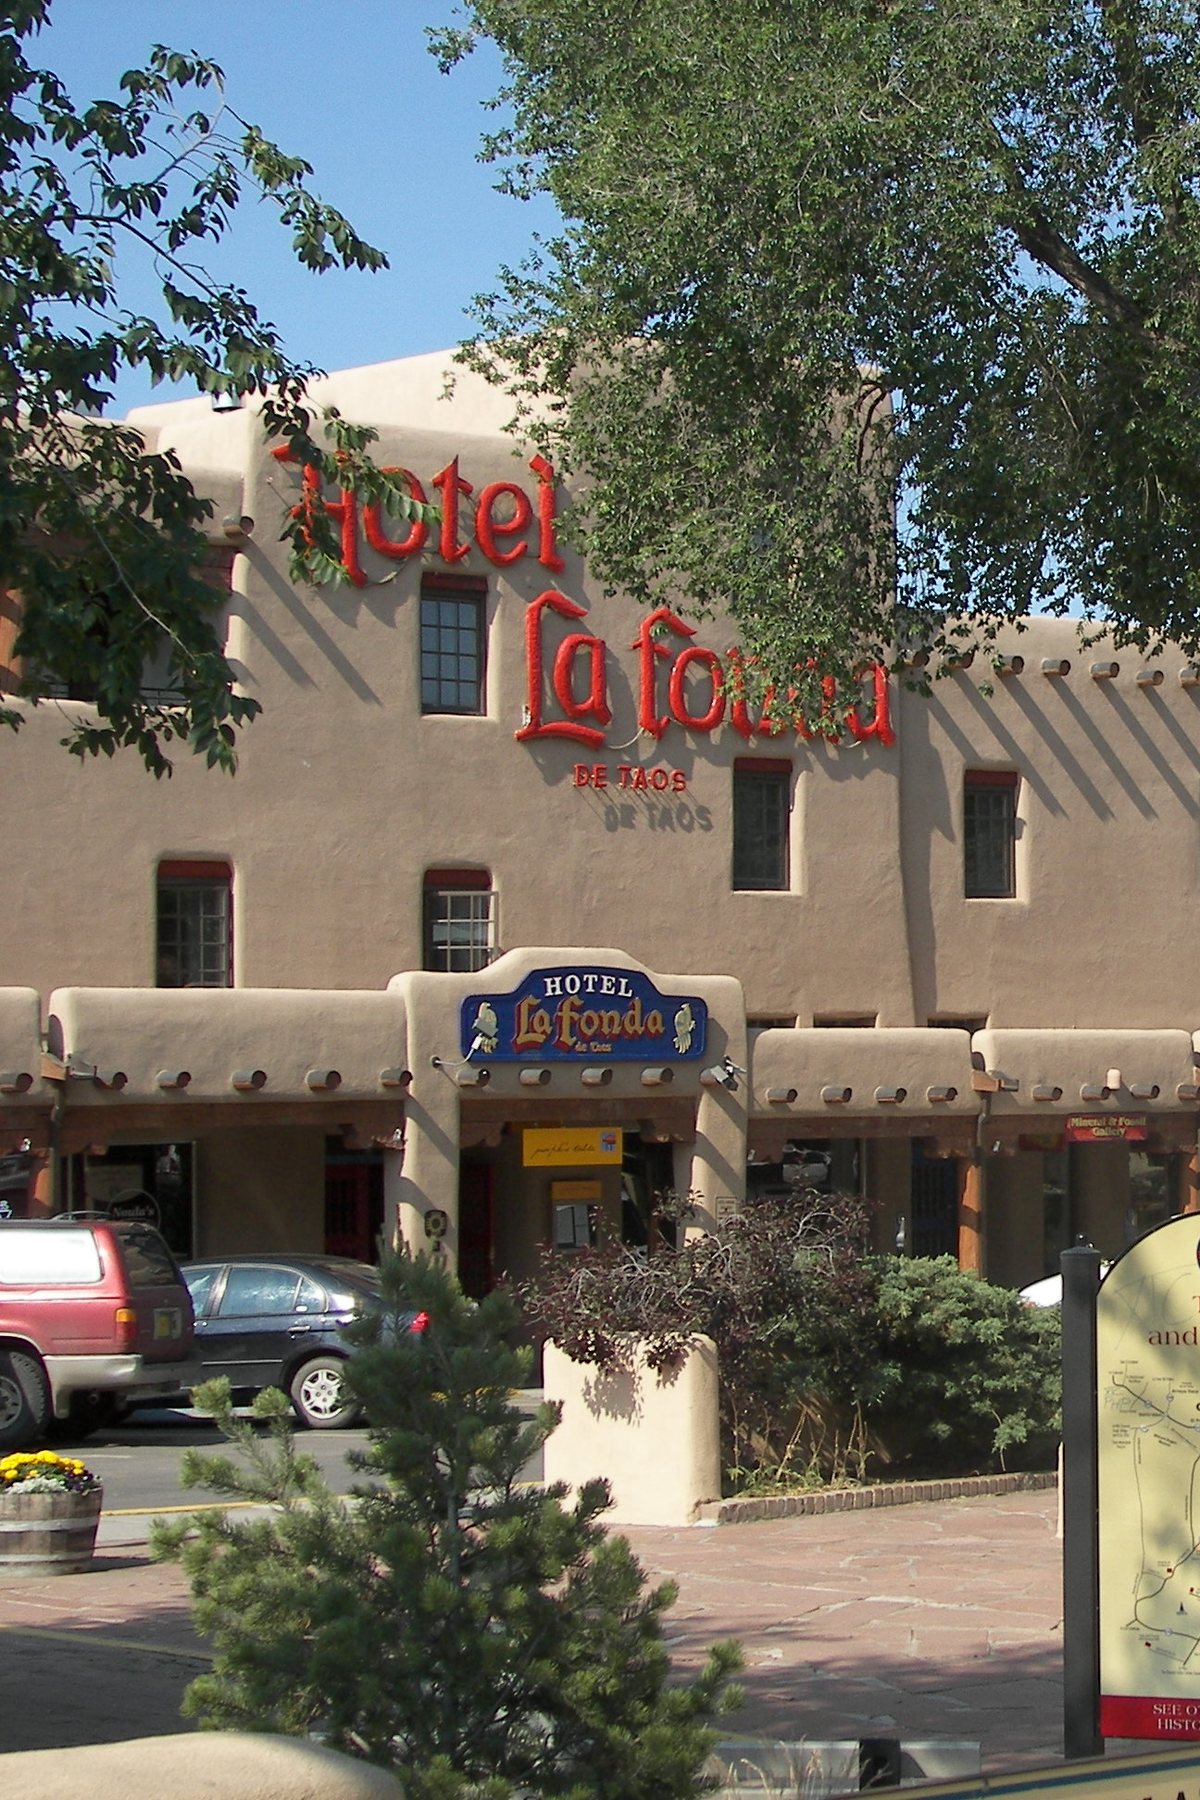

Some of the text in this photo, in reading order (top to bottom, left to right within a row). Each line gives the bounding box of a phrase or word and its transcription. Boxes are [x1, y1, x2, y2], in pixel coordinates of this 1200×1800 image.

[271, 443, 565, 588] Hotel
[514, 589, 612, 750] La
[573, 763, 687, 791] DE TAOS
[543, 974, 633, 998] HOTEL
[511, 994, 553, 1053] La
[1071, 1117, 1106, 1127] Mineral
[1118, 1117, 1146, 1127] Fossil
[1092, 1127, 1126, 1137] Gallery
[1148, 1326, 1198, 1346] and
[1153, 1703, 1182, 1716] SEE
